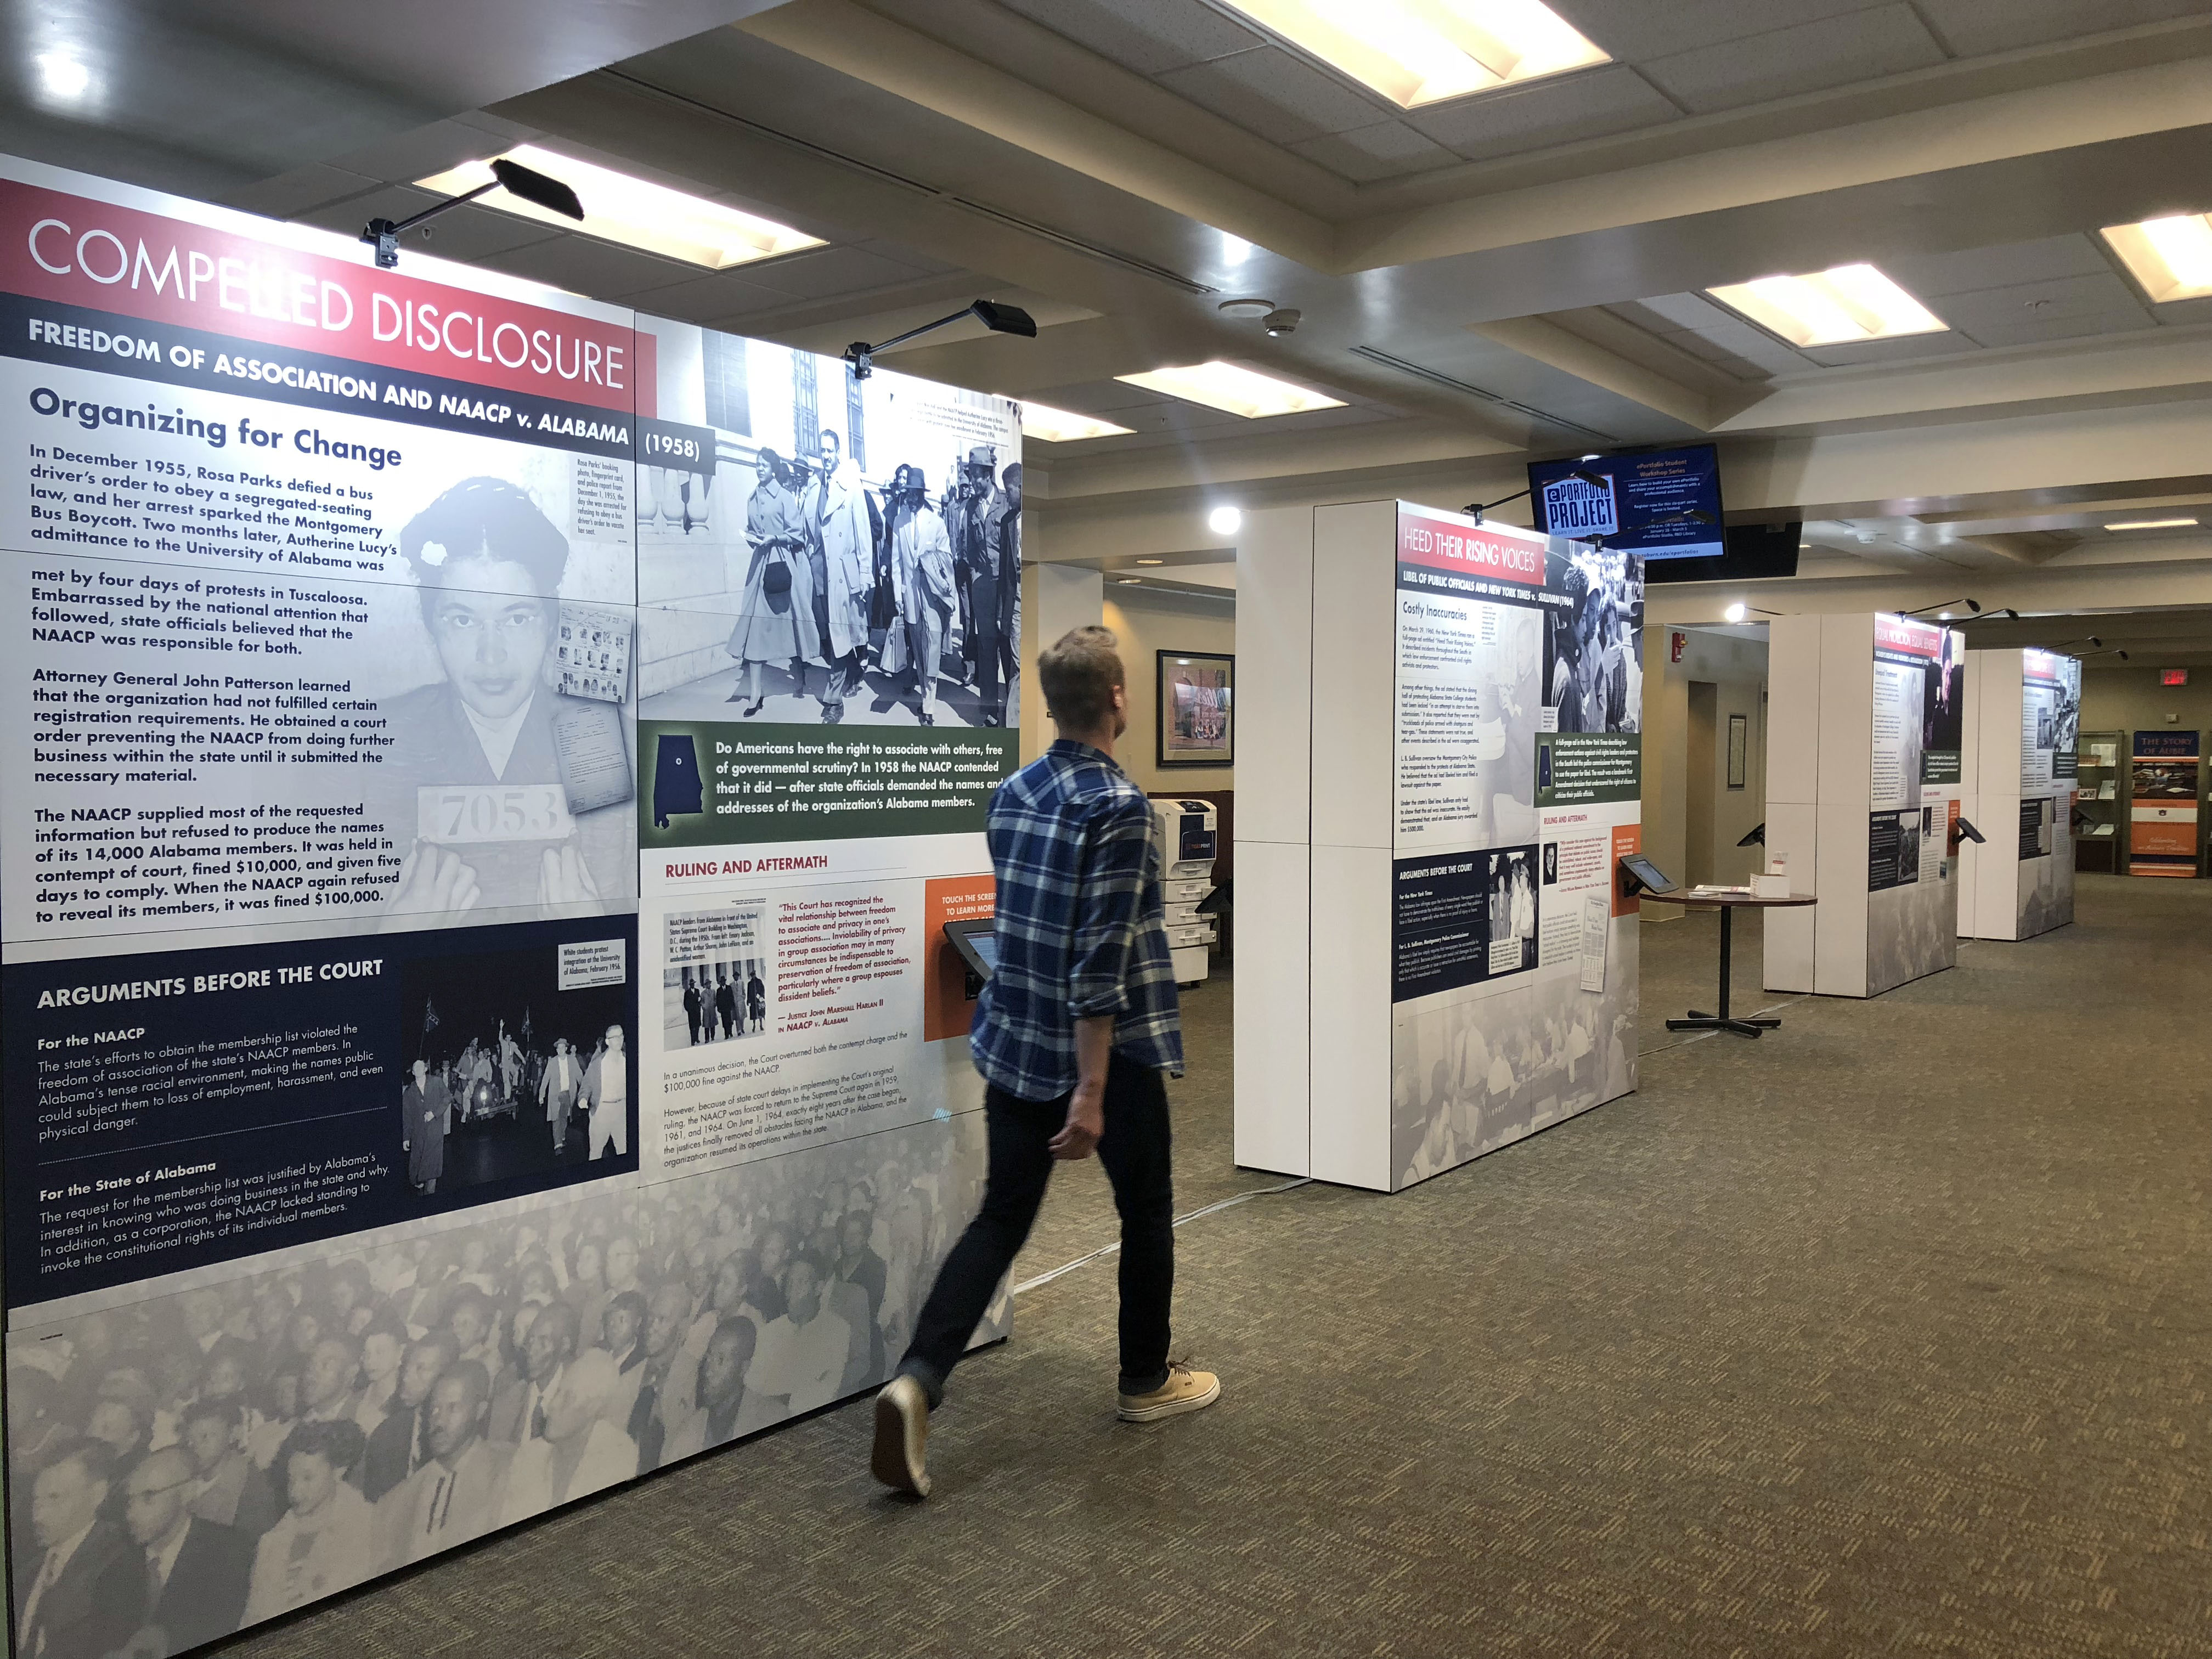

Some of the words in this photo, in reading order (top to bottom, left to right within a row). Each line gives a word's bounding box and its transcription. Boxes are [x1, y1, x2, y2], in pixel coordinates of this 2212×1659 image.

[29, 219, 353, 331] COMPELLED
[373, 292, 624, 390] DISCLOSURE
[30, 319, 161, 363] FREEDOM
[170, 346, 205, 369] OF
[213, 354, 376, 401] ASSOCIATION
[383, 385, 432, 410] AND
[439, 394, 511, 423] NAACP
[517, 414, 532, 428] v.
[538, 414, 629, 445] ALABAMA
[645, 432, 701, 462] (1958)
[30, 387, 225, 448] Organizing
[238, 418, 283, 448] for
[294, 429, 402, 470] Change
[30, 444, 46, 458] In
[53, 447, 138, 470] December
[145, 459, 191, 478] 1955,
[198, 466, 234, 482] Rosa
[240, 472, 282, 488] Parks
[287, 478, 331, 495] defied
[336, 488, 344, 496] a
[350, 486, 373, 500] bus
[578, 459, 587, 467] Rosa
[588, 460, 601, 469] Parks'
[602, 462, 618, 473] booking
[1549, 498, 1612, 529] PROJECT
[1405, 527, 1432, 552] HEED
[1435, 533, 1463, 559] THEIR
[1466, 539, 1499, 565] RISING
[1501, 546, 1534, 572] VOICES
[1403, 571, 1418, 583] LIBEL
[1419, 573, 1427, 584] OF
[1428, 574, 1447, 587] PUBLIC
[1448, 577, 1475, 591] OFFICIALS
[1475, 582, 1488, 593] AND
[1488, 584, 1502, 595] NEW
[1502, 586, 1516, 598] YORK
[1517, 589, 1531, 600] TIMES
[1538, 592, 1559, 605] SULLIVAN
[1403, 601, 1424, 618] Costly
[1426, 605, 1466, 620] Inaccuracies
[32, 669, 108, 687] Attorney
[114, 672, 177, 686] General
[183, 674, 219, 687] John
[225, 676, 293, 690] Patterson
[299, 679, 350, 692] learned
[716, 742, 732, 753] Do
[736, 742, 794, 754] Americans
[798, 742, 823, 754] have
[827, 742, 843, 754] the
[847, 742, 870, 757] right
[872, 744, 882, 754] to
[885, 743, 928, 754] associate
[930, 743, 950, 754] with
[953, 743, 983, 756] others,
[986, 744, 1002, 754] free
[441, 792, 558, 837] 7053
[1544, 816, 1558, 825] RULING
[666, 862, 718, 878] RULING
[722, 860, 752, 874] AND
[757, 855, 827, 872] AFTERMATH
[1400, 868, 1429, 880] ARGUMENTS
[1430, 866, 1447, 876] BEFORE
[1448, 865, 1457, 873] THE
[1457, 863, 1472, 872] COURT
[799, 902, 819, 910] Court
[834, 897, 871, 907] recognized
[942, 895, 963, 904] TOUCH
[957, 906, 975, 915] LEARN
[978, 904, 995, 912] MORE
[594, 946, 608, 955] protest
[563, 958, 586, 967] integration
[37, 978, 185, 1008] ARGUMENTS
[194, 970, 270, 992] BEFORE
[278, 966, 312, 984] THE
[320, 960, 382, 980] COURT
[787, 1021, 812, 1031] NAACP
[38, 1039, 61, 1050] For
[66, 1035, 88, 1047] the
[94, 1028, 145, 1043] NAACP
[40, 1190, 64, 1201] For
[68, 1184, 91, 1196] the
[96, 1178, 131, 1191] State
[136, 1171, 150, 1184] of
[154, 1163, 216, 1181] Alabama
